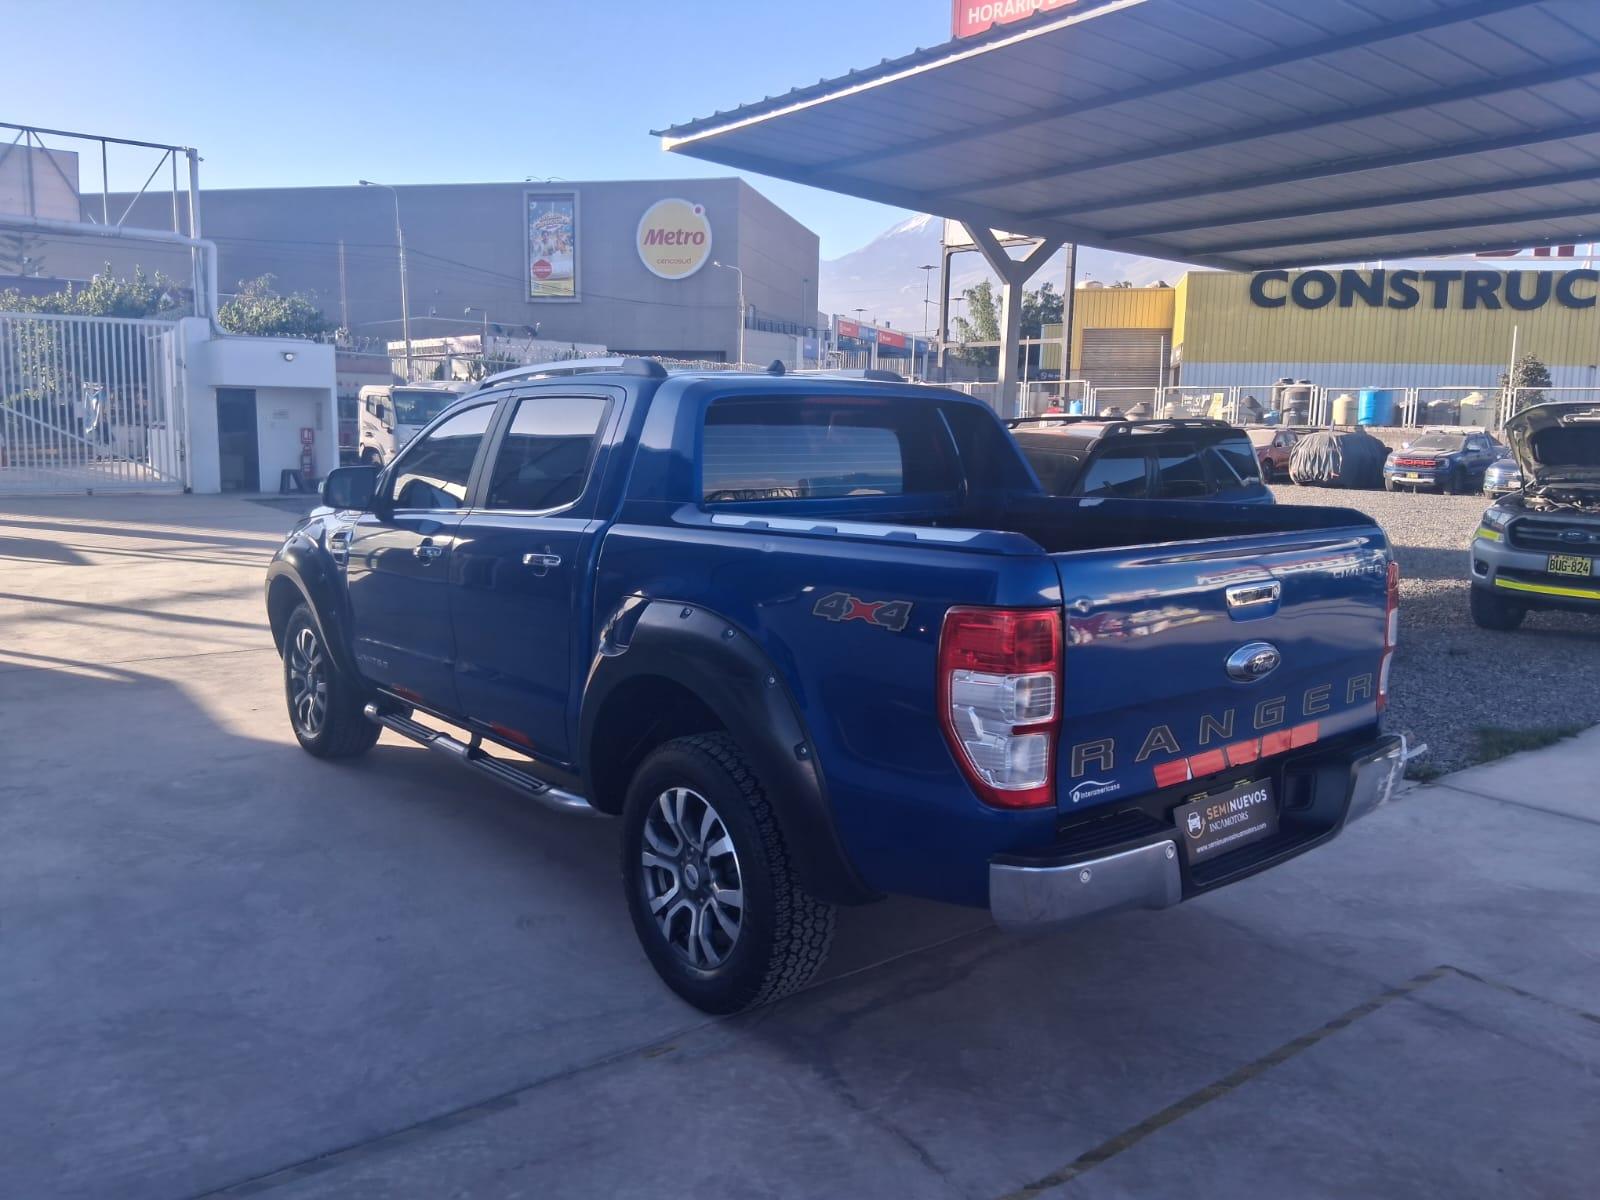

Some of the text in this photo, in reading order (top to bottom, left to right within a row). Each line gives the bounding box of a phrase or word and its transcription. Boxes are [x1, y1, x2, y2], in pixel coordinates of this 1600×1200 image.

[968, 0, 1041, 24] HORARIO
[643, 228, 705, 246] Metro
[656, 257, 692, 265] cencosud
[1250, 269, 1599, 311] CONSTRUC
[1549, 559, 1589, 574] BUG-824
[1071, 673, 1373, 778] RANGER
[1206, 789, 1267, 820] SEMINUEVOS
[1208, 811, 1249, 833] INCAMOTORS
